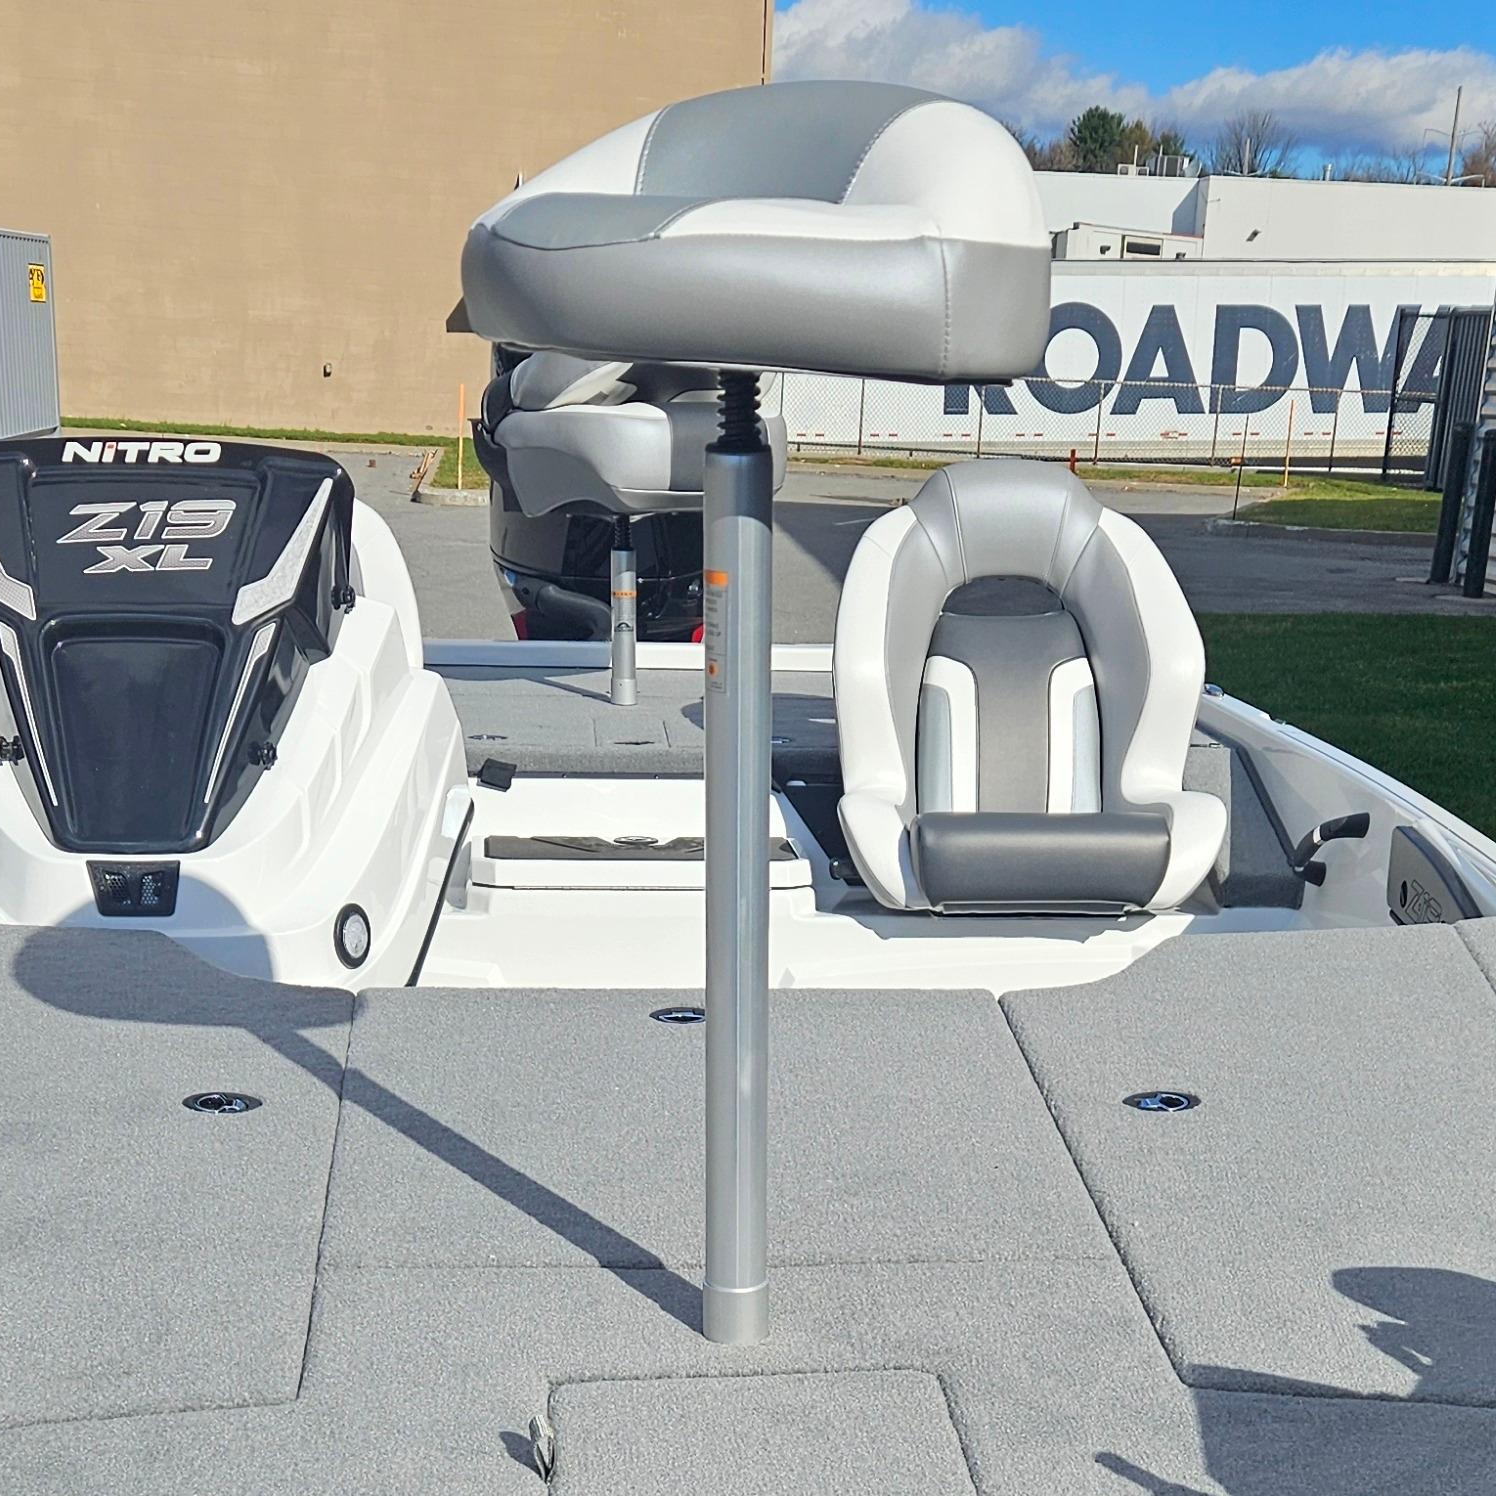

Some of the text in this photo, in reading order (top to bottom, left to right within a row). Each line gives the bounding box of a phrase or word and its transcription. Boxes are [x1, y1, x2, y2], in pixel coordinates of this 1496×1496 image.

[943, 301, 1448, 414] OADWA
[56, 500, 237, 544] Z19
[83, 544, 214, 574] XL
